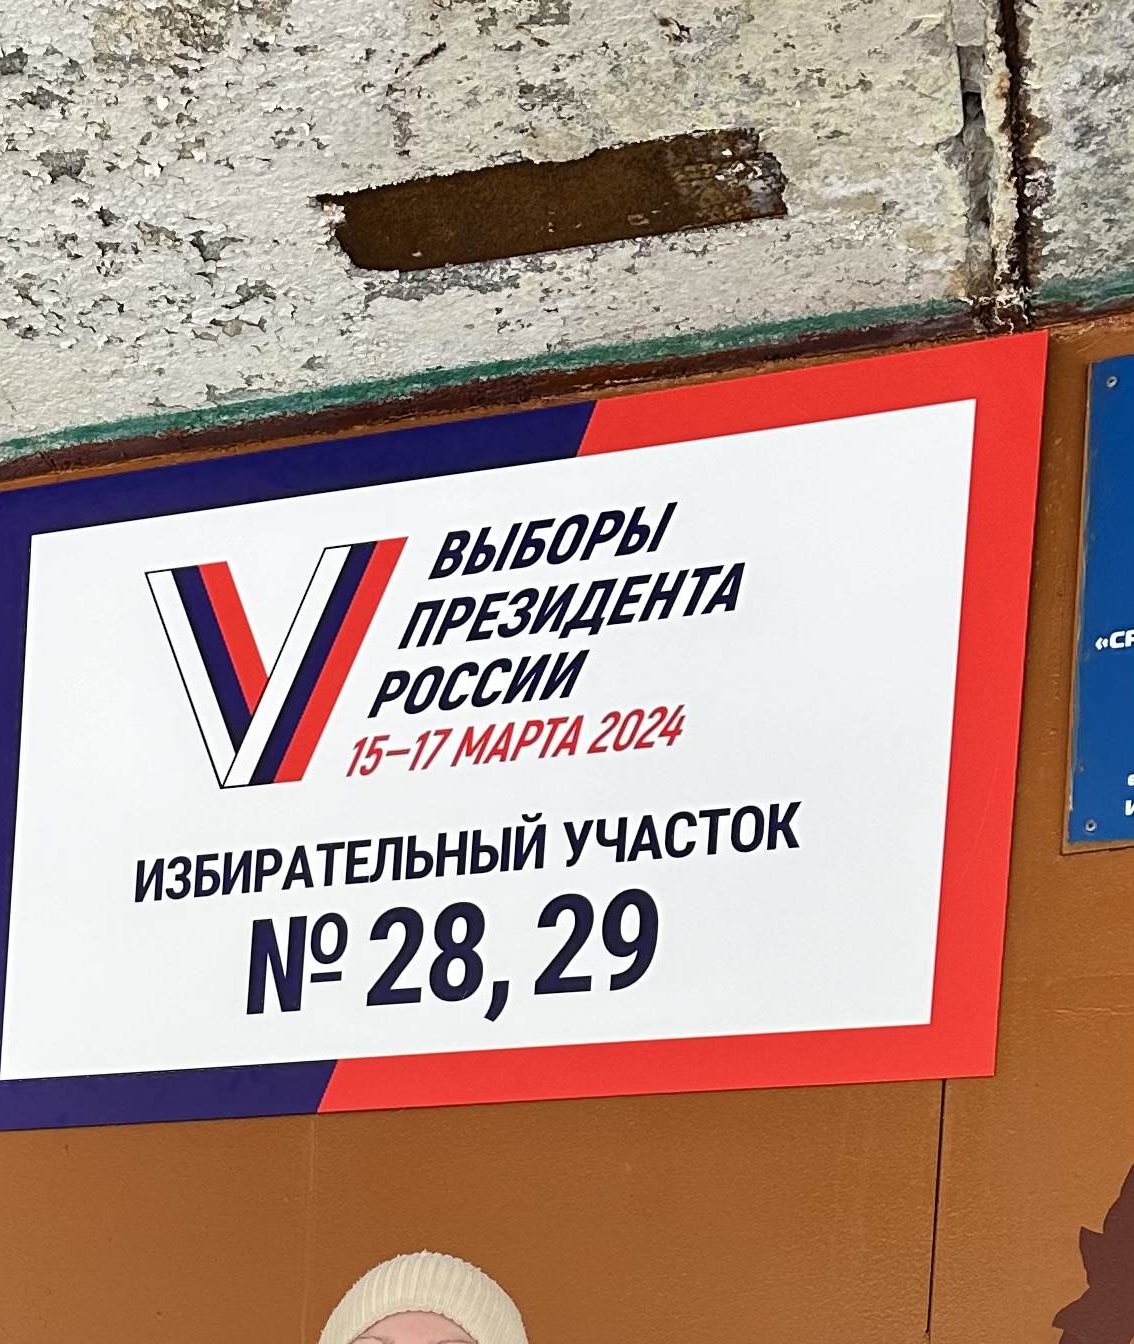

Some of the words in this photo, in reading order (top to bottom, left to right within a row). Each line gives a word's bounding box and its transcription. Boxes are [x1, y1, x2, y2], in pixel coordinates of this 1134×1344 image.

[427, 501, 678, 580] ВЫБОРЫ
[397, 561, 746, 650] ПРЕЗИДЕНТА
[366, 648, 591, 719] РОССИИ
[450, 715, 584, 767] МАРТА
[586, 704, 686, 754] 2024
[134, 812, 547, 903] ИЗБИРАТЕЛЬНЫЙ
[563, 801, 802, 868] УЧАСТОК
[246, 912, 349, 1015] №
[366, 901, 510, 1022] 28,
[533, 888, 659, 996] 29
